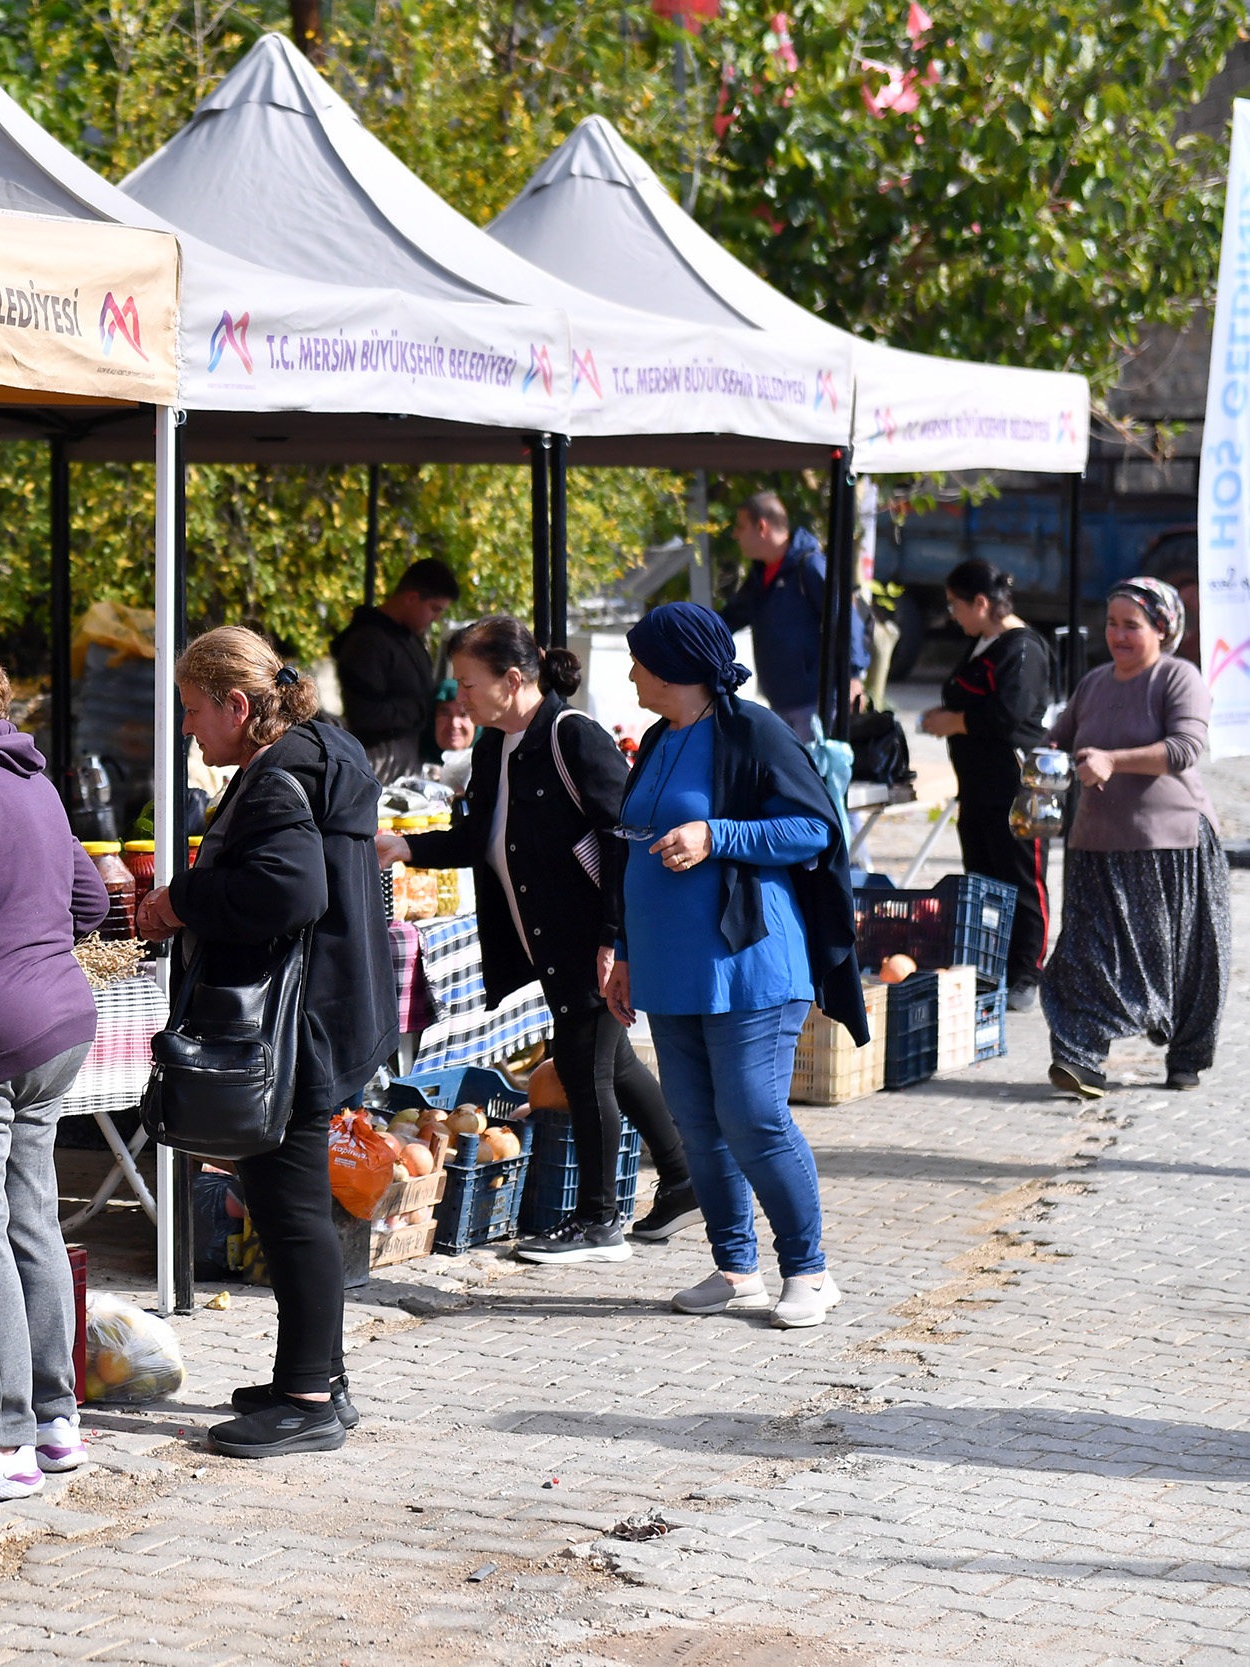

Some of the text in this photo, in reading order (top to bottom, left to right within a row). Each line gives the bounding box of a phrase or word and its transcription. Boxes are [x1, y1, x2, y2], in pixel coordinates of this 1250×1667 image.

[266, 328, 518, 387] T.C. MERSİN BÜYÜKŞEHİR BELEDİYESİ
